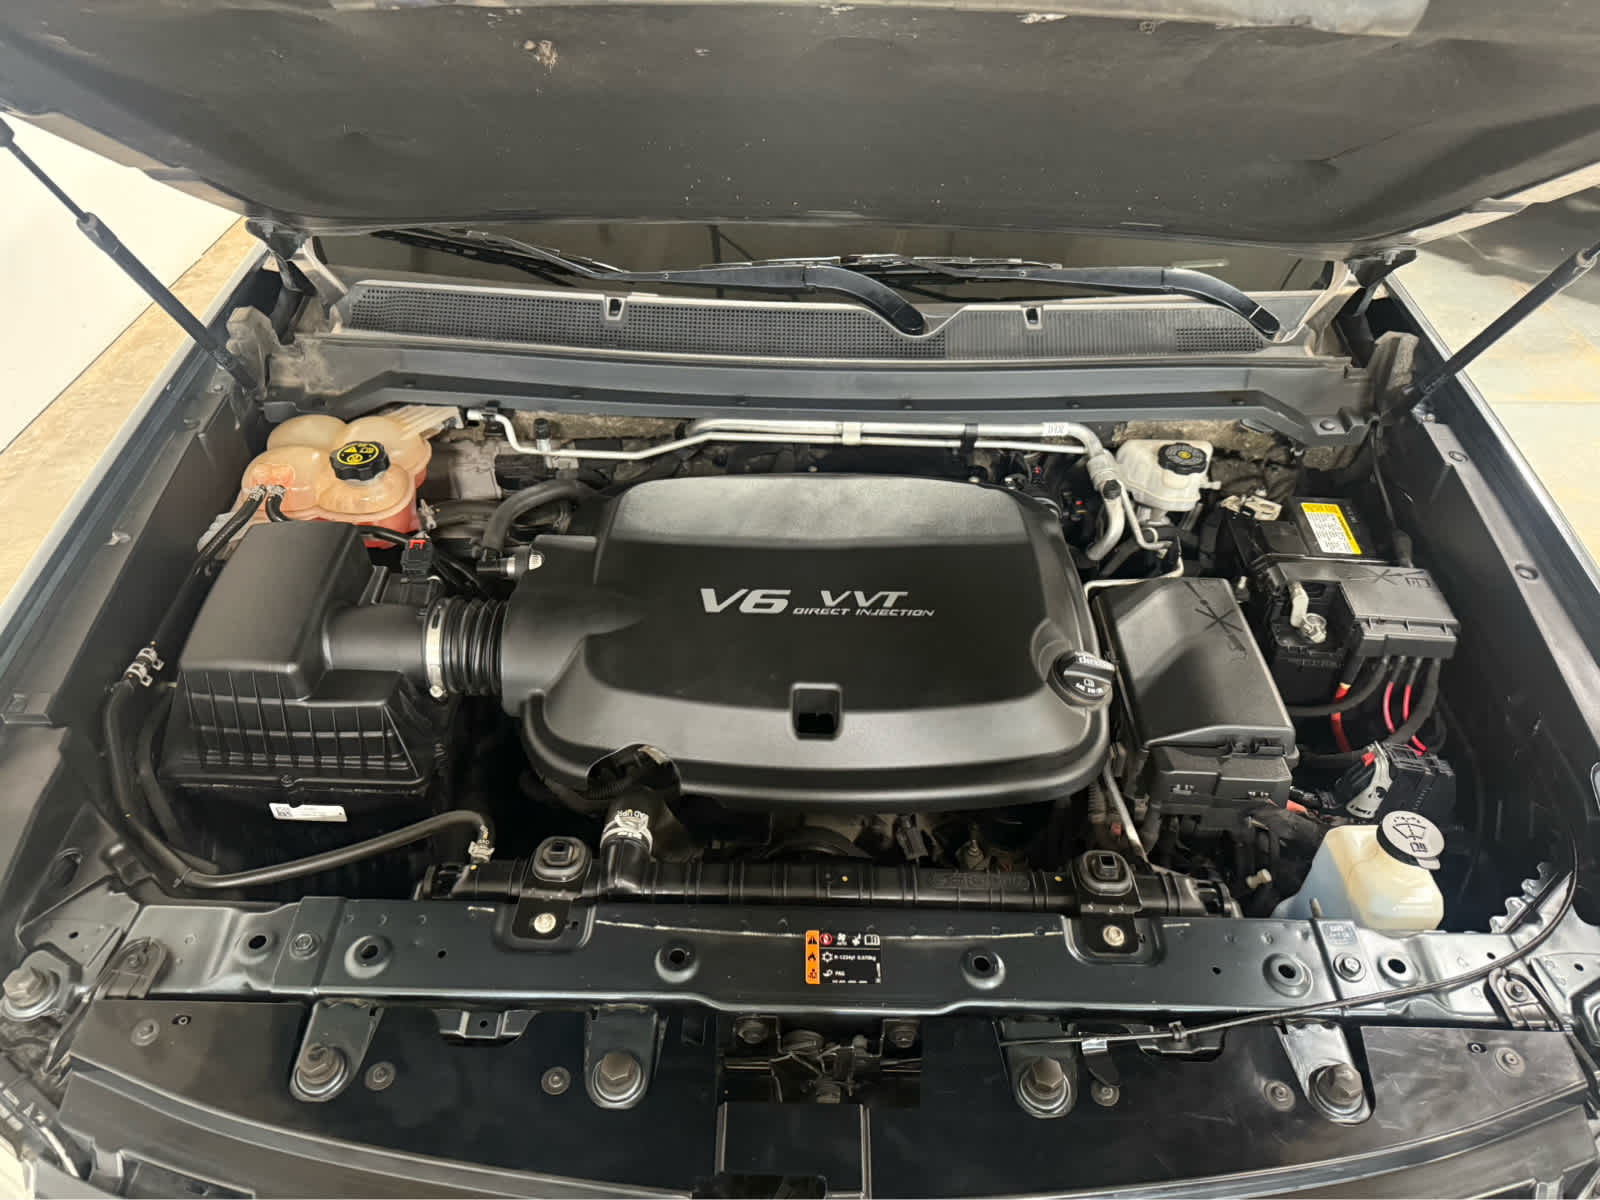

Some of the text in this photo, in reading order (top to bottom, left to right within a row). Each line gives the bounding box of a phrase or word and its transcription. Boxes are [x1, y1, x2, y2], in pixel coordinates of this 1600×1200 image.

[700, 588, 909, 613] V6 VVT
[792, 608, 935, 617] DIRECT INJECTION
